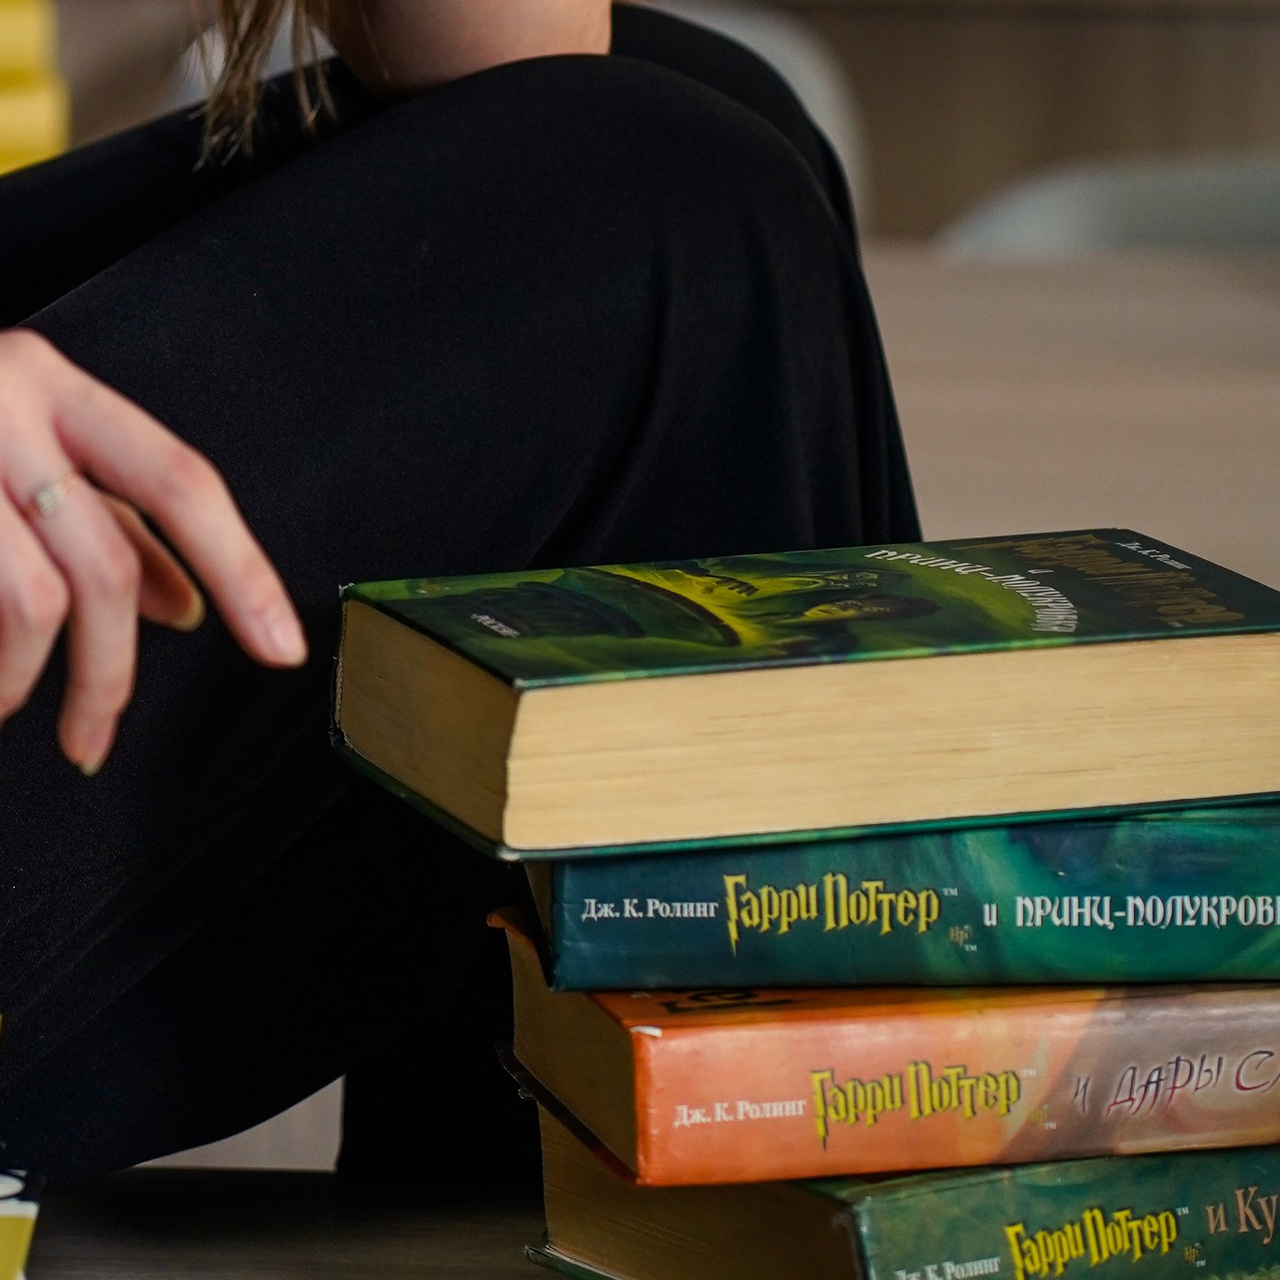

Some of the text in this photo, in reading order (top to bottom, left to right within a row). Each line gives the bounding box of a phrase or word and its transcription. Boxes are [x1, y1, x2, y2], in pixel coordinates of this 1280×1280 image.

[581, 898, 620, 922] Дж.
[623, 898, 644, 918] К.
[646, 898, 719, 918] Ролинг
[723, 873, 819, 957] Гарри
[823, 872, 940, 935] Поттер
[982, 903, 998, 927] и
[673, 1104, 711, 1129] Дж.
[714, 1101, 734, 1123] К.
[736, 1099, 807, 1121] Ролинг
[810, 1069, 904, 1151] Гарри
[907, 1060, 1021, 1121] Поттер
[1105, 1054, 1224, 1116] ДАРЫ
[1235, 1050, 1280, 1093] С
[942, 1257, 1001, 1280] Ролинг
[1004, 1220, 1086, 1280] Гарри
[1081, 1207, 1179, 1268] Поттер
[1206, 1203, 1228, 1234] и
